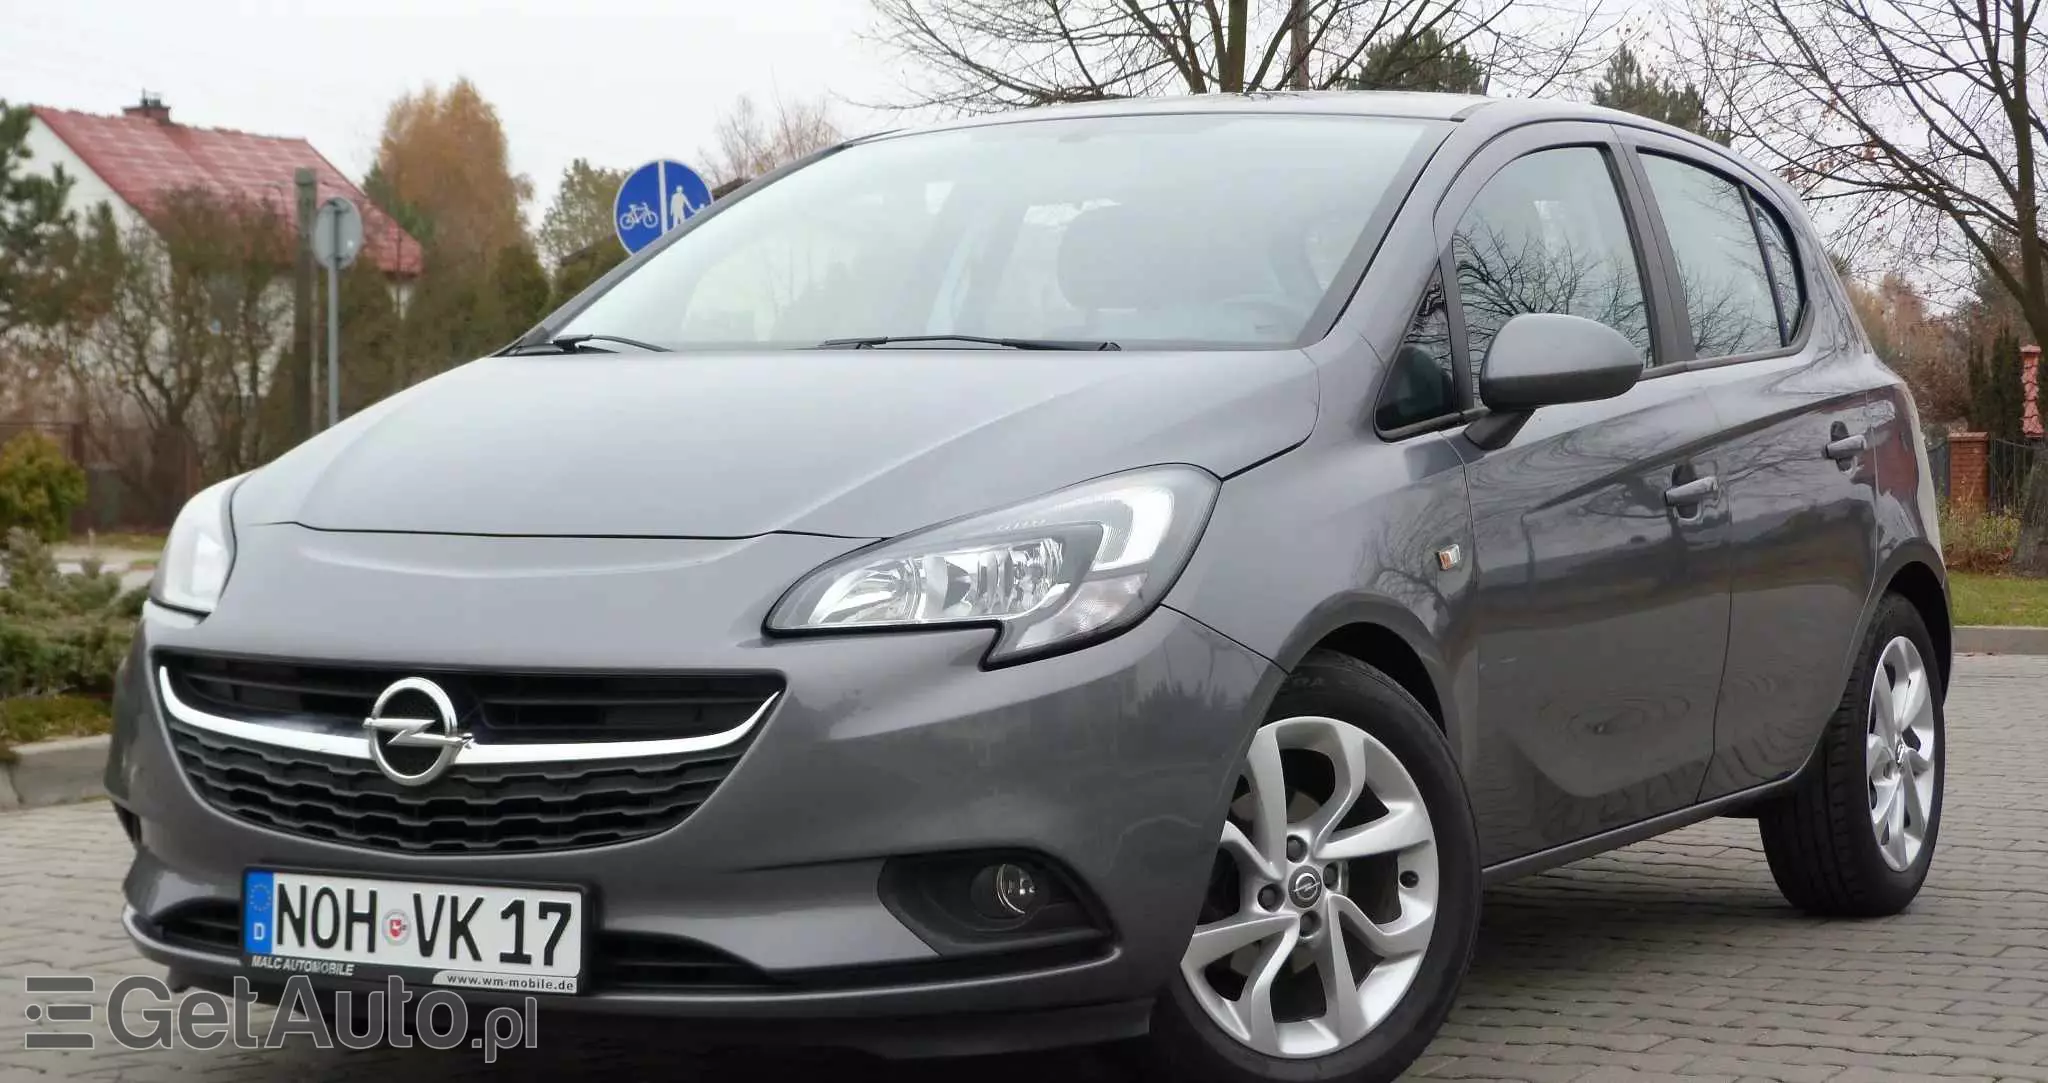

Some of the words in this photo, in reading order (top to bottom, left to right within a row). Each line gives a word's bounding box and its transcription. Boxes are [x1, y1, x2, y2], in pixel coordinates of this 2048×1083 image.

[253, 922, 266, 941] D
[277, 883, 377, 953] NOH
[413, 893, 485, 962] VK
[499, 899, 572, 967] 17
[251, 955, 283, 970] MALC
[283, 958, 355, 976] AUTOMOBILE
[447, 974, 574, 991] www.wm-mobile.de
